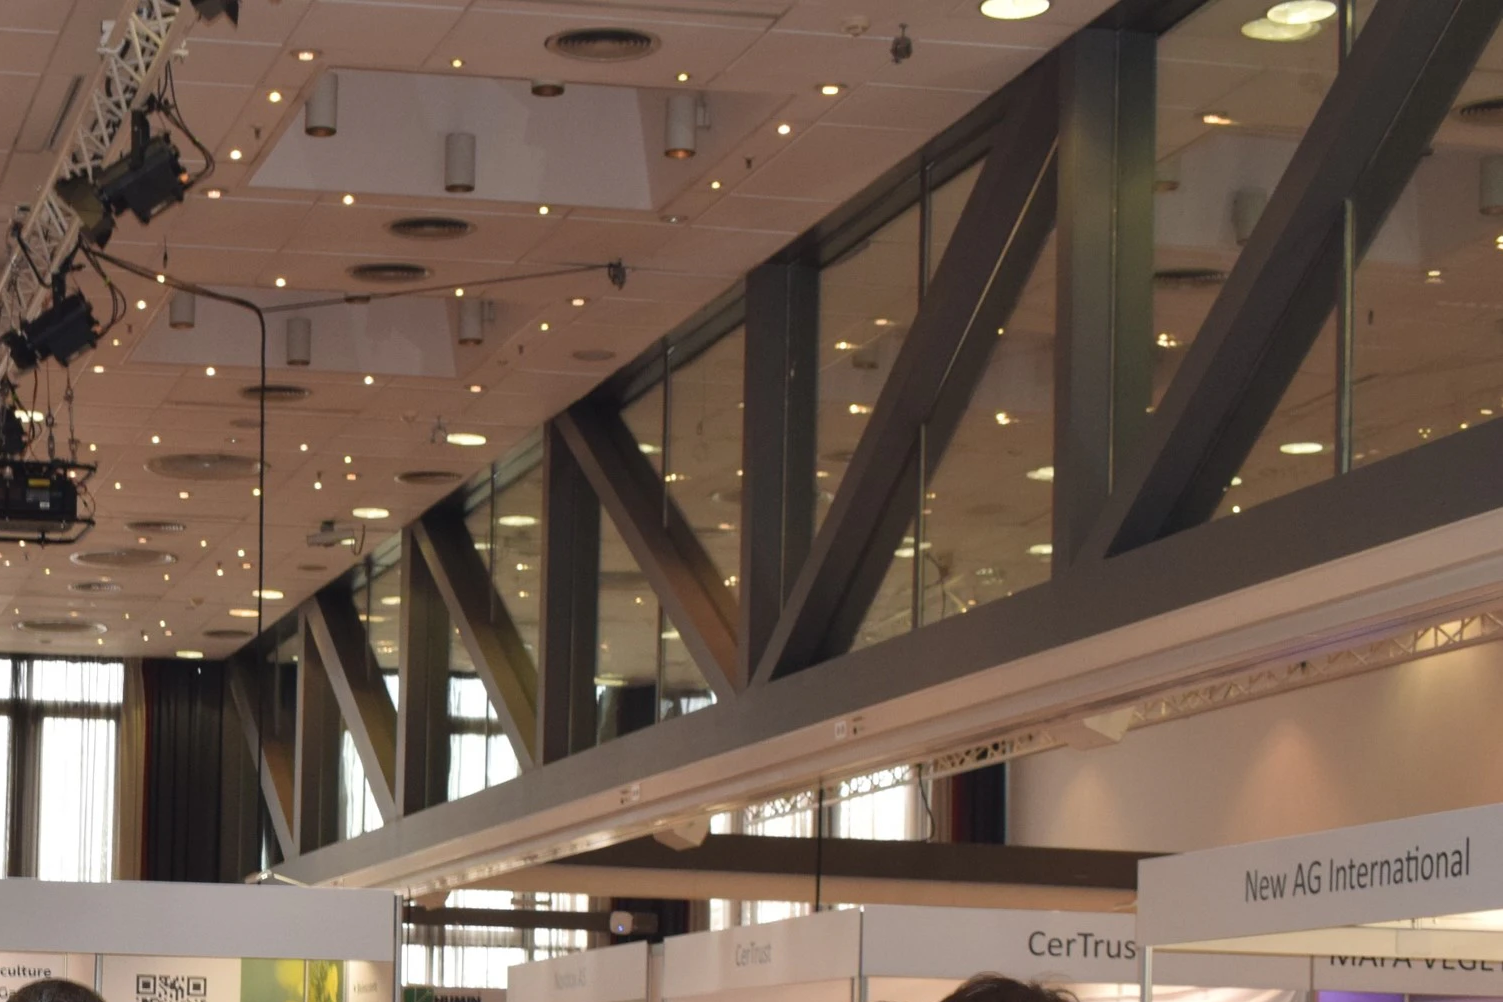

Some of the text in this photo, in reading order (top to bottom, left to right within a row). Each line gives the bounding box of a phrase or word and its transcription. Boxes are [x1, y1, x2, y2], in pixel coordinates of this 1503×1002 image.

[1245, 837, 1471, 902] New AG International
[1028, 930, 1138, 959] CerTrus
